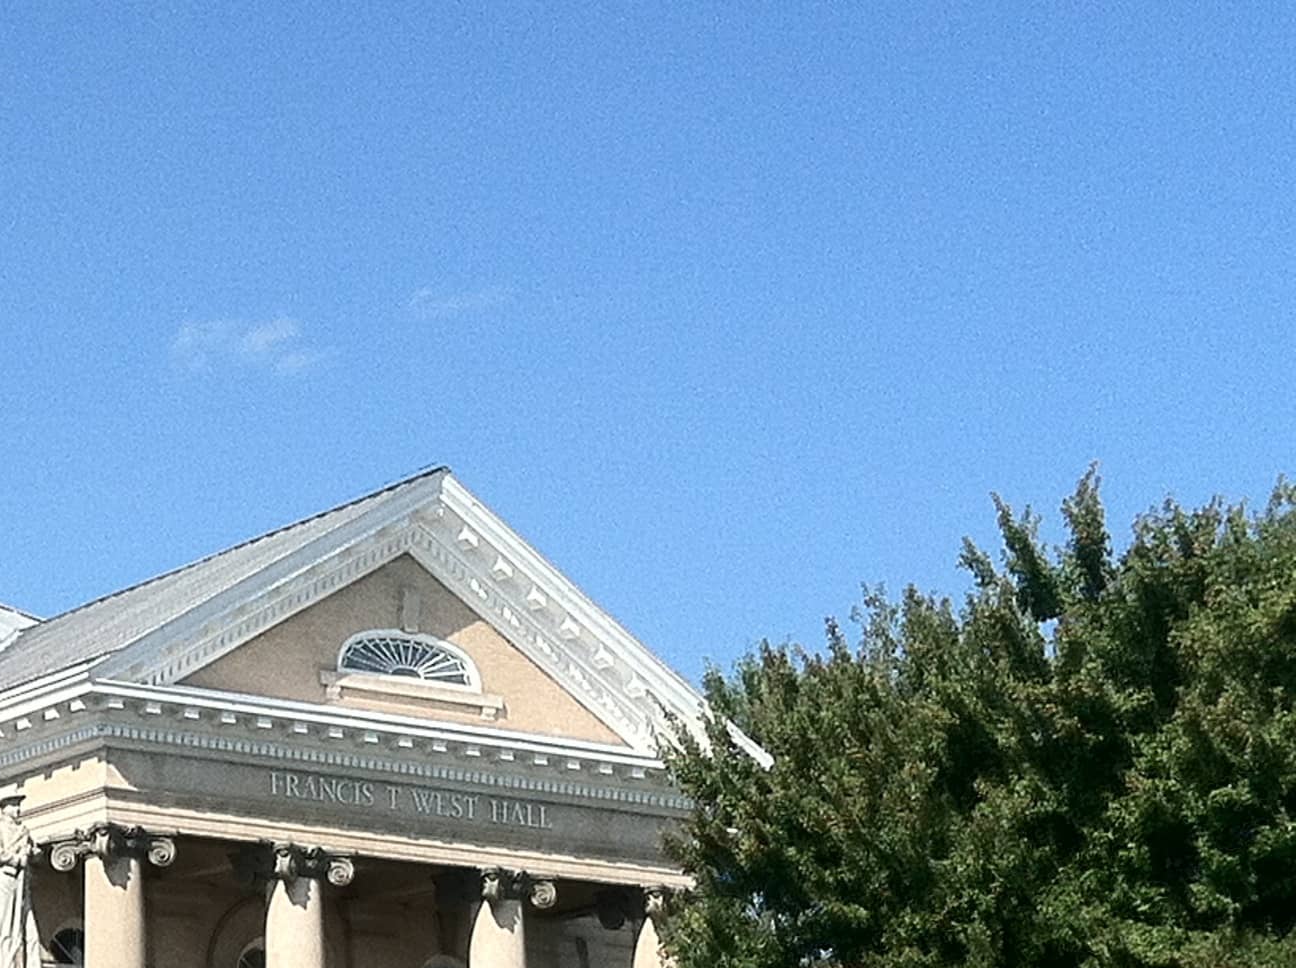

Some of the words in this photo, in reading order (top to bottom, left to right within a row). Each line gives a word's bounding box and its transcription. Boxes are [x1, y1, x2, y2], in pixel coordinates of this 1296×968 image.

[270, 771, 375, 806] FRANCIS
[386, 786, 403, 810] T
[409, 788, 481, 820] WEST
[489, 799, 553, 828] HALL
